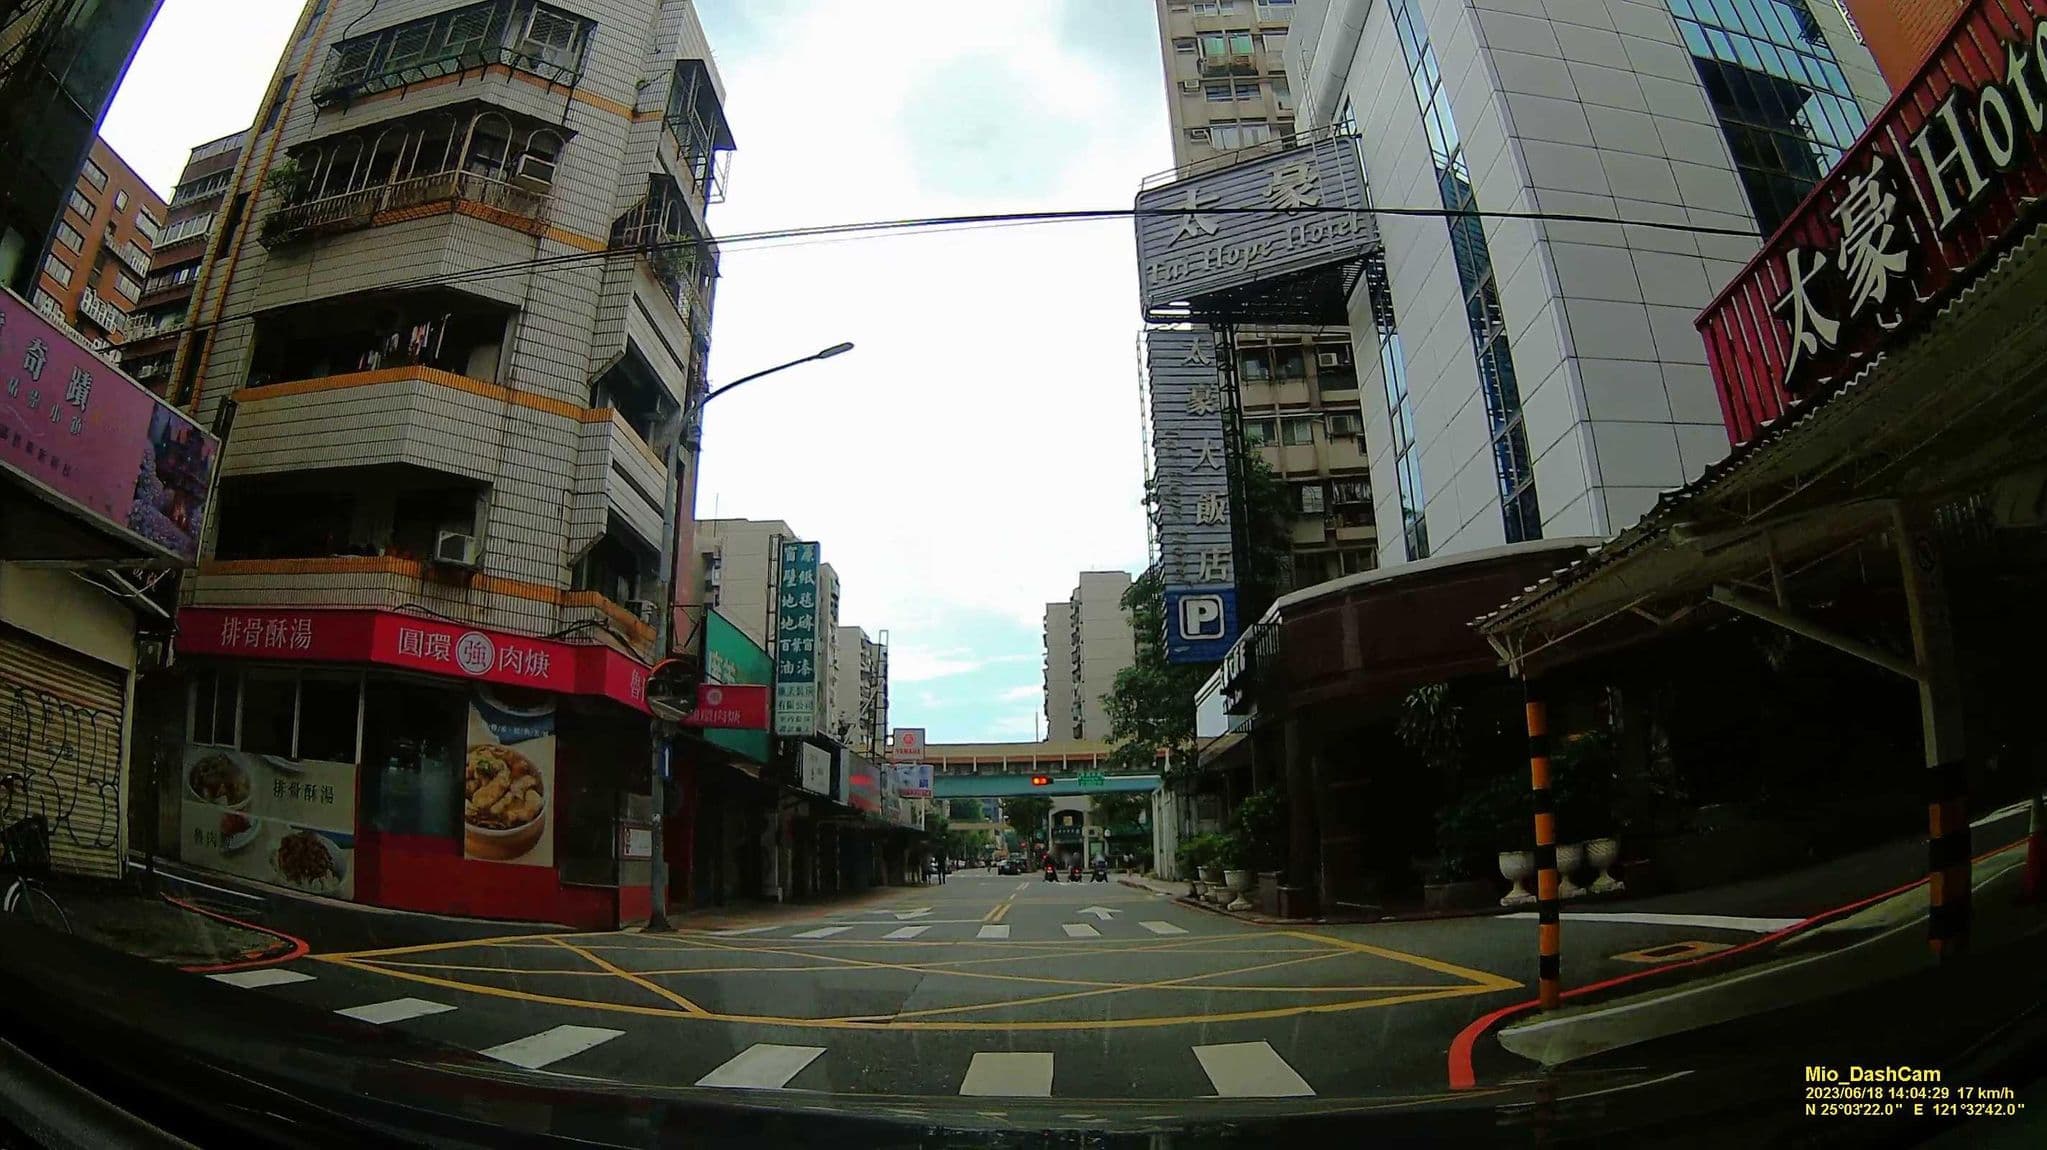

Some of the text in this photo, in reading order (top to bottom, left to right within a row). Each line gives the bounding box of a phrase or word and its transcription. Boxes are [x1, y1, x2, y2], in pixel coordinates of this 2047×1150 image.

[1168, 160, 1320, 248] 太豪
[1199, 239, 1274, 271] Hope
[1284, 212, 1361, 251] Hotel
[1771, 155, 1909, 386] 太豪
[1182, 338, 1233, 583] 太豪大飯店
[782, 568, 815, 587] 壁紙
[781, 592, 814, 609] 地毯
[221, 616, 313, 650] 排骨酥湯
[1186, 601, 1219, 635] P
[780, 659, 813, 676] 油漆
[273, 778, 335, 804] 排骨酥湯
